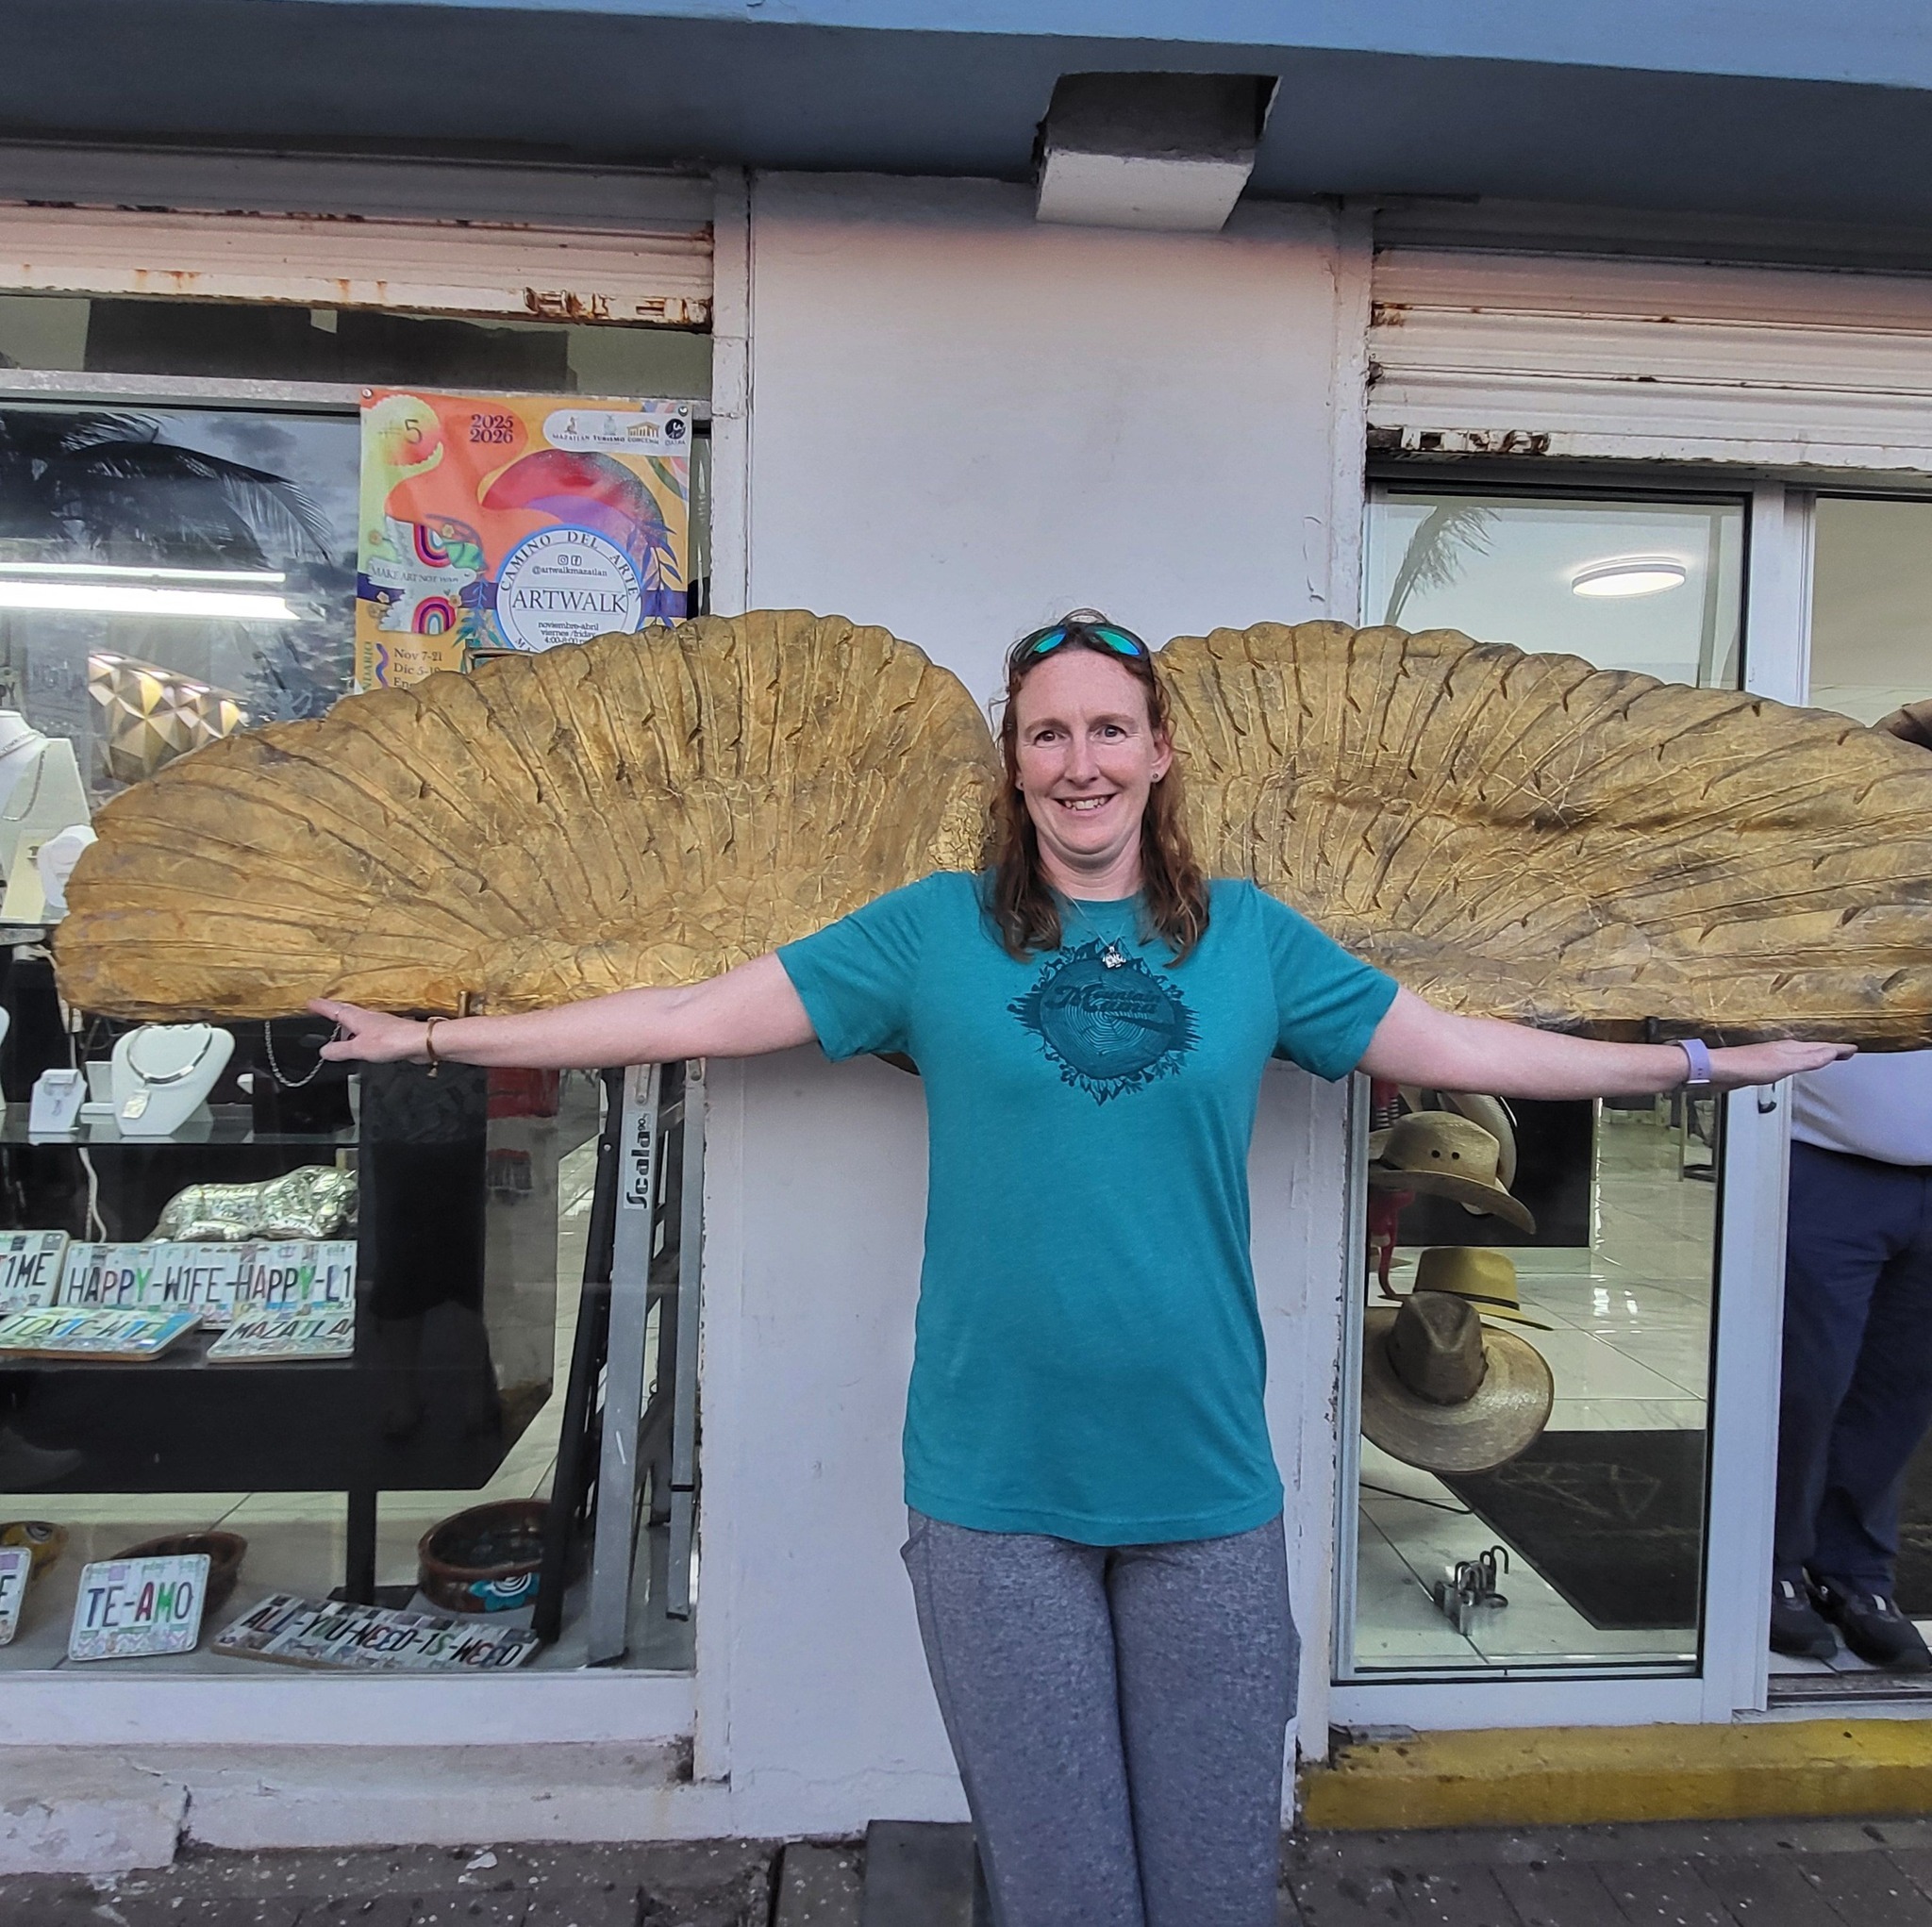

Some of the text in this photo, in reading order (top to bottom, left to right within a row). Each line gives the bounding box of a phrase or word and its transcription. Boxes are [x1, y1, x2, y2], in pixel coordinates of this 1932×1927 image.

[471, 414, 514, 429] 2025
[470, 428, 513, 443] 2026
[500, 531, 639, 596] CAMINO DEL ARTE
[532, 566, 608, 577] @artwalkmazatlan
[511, 589, 627, 613] ARTWALK
[393, 647, 442, 662] Nov 7-21
[393, 662, 414, 674] Dic
[87, 1581, 193, 1628] TE-AMO
